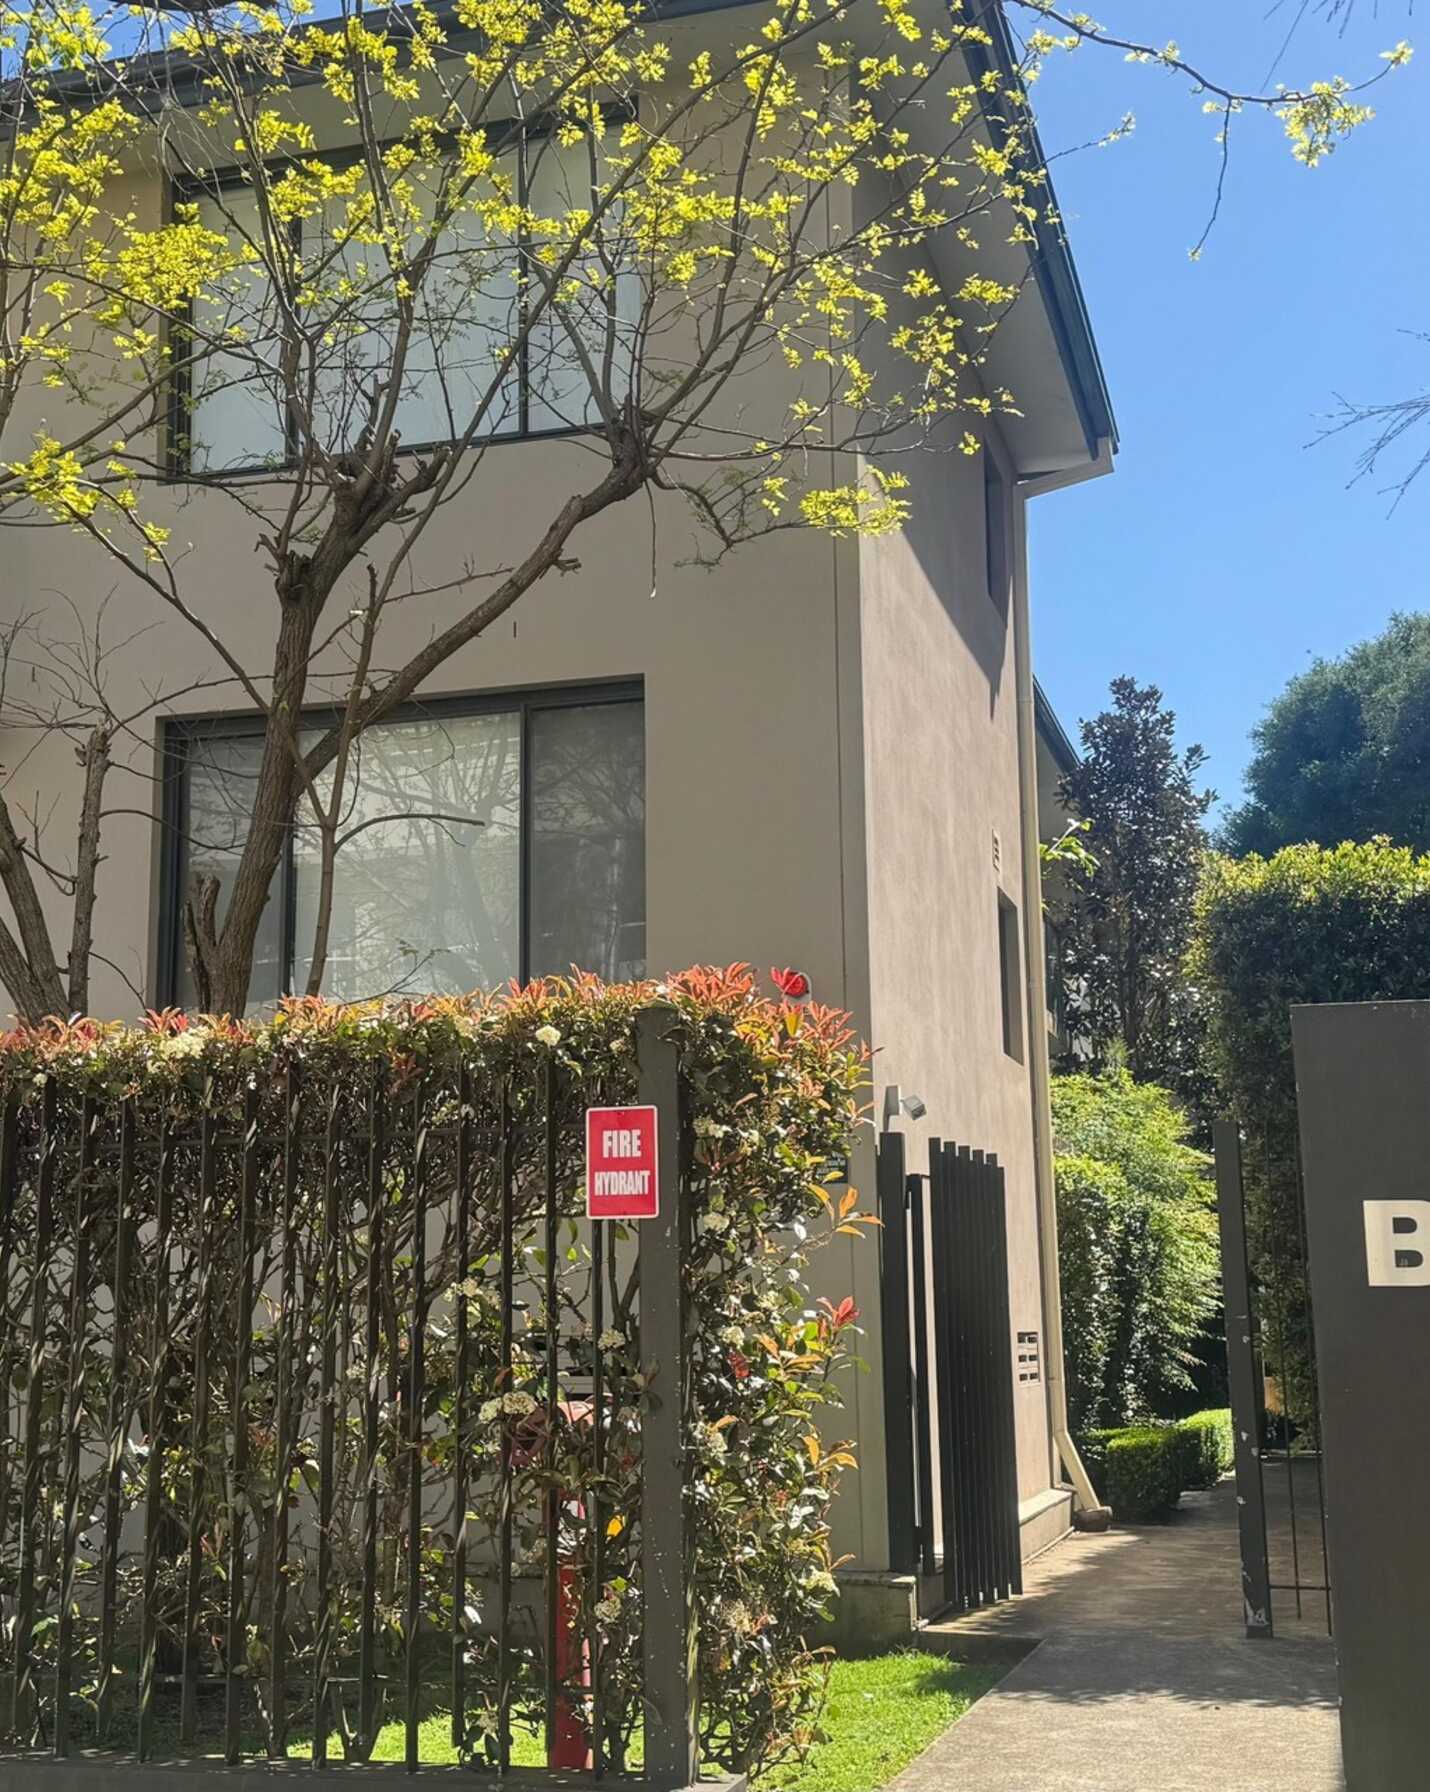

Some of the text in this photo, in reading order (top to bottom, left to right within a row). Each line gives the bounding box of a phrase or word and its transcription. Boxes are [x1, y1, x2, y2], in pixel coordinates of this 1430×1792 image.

[602, 1129, 642, 1158] FIRE
[594, 1170, 651, 1197] HYDRANT
[1363, 1200, 1430, 1287] B
